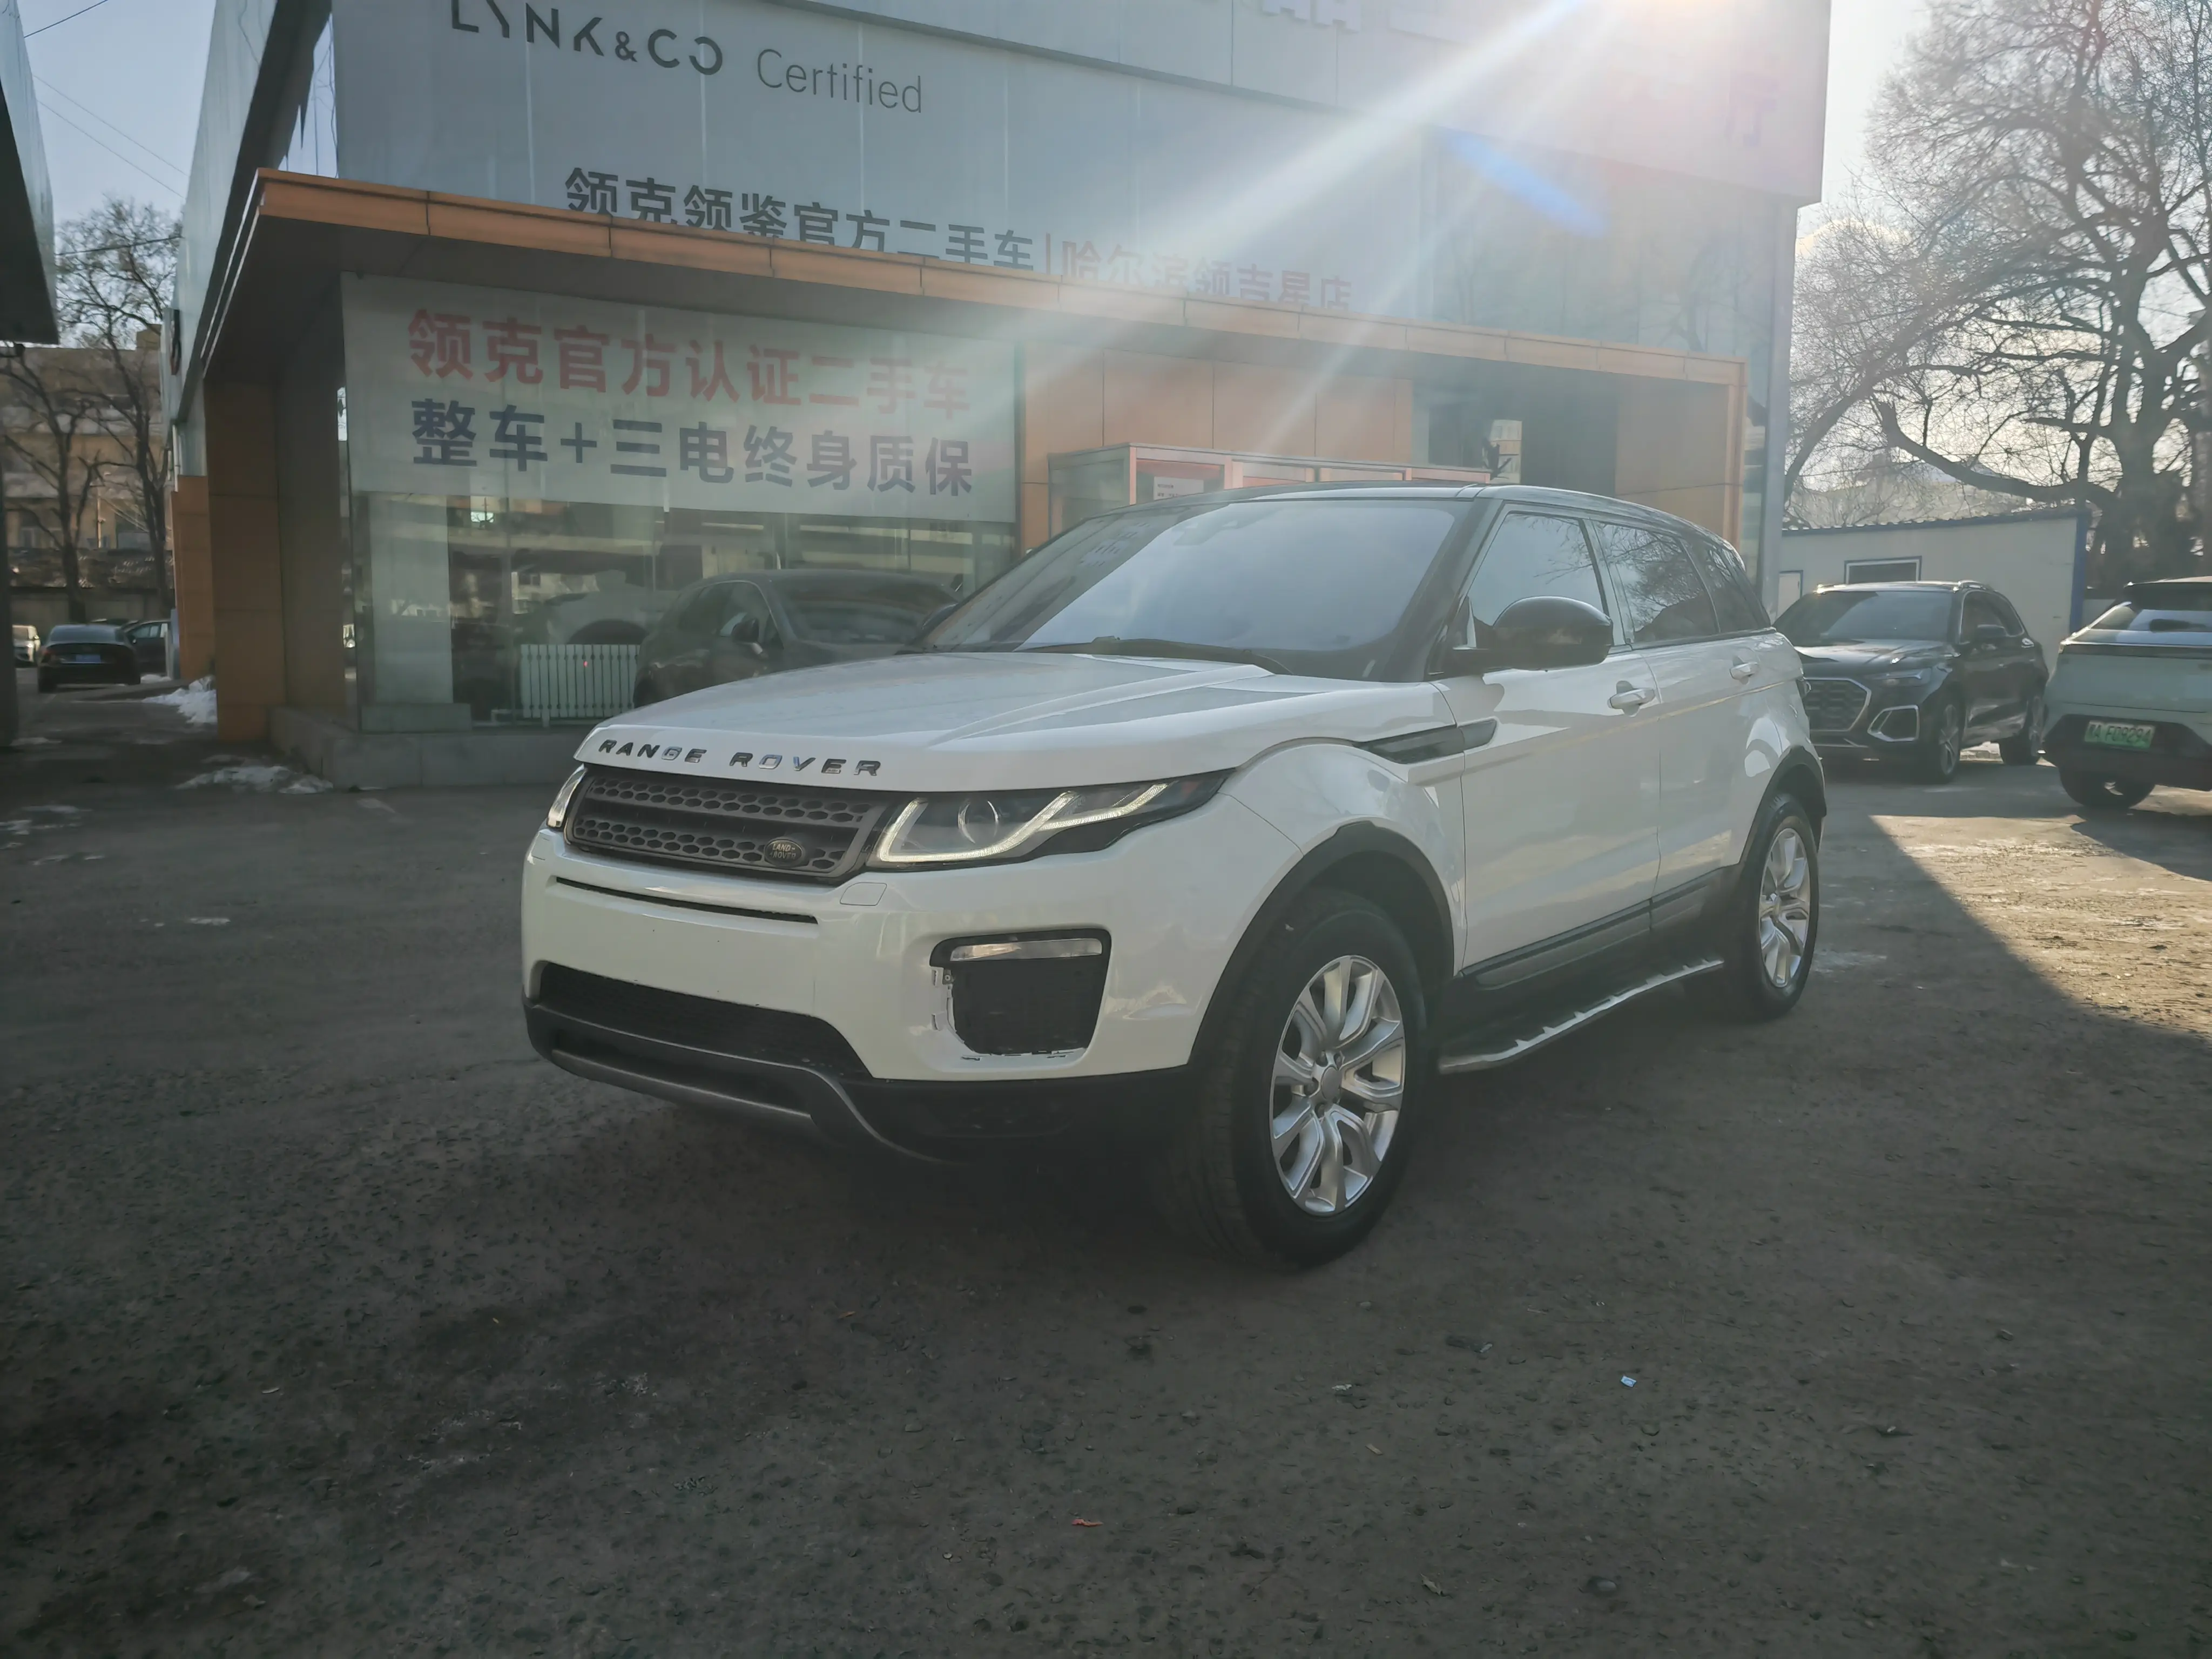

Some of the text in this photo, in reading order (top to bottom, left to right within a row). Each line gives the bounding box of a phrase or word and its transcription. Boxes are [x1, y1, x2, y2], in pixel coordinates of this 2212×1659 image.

[757, 48, 922, 113] Certified
[407, 307, 970, 421] 领克官方认证二手车
[411, 398, 973, 497] 整车+三电终身质保
[598, 739, 881, 777] RANGE ROVER
